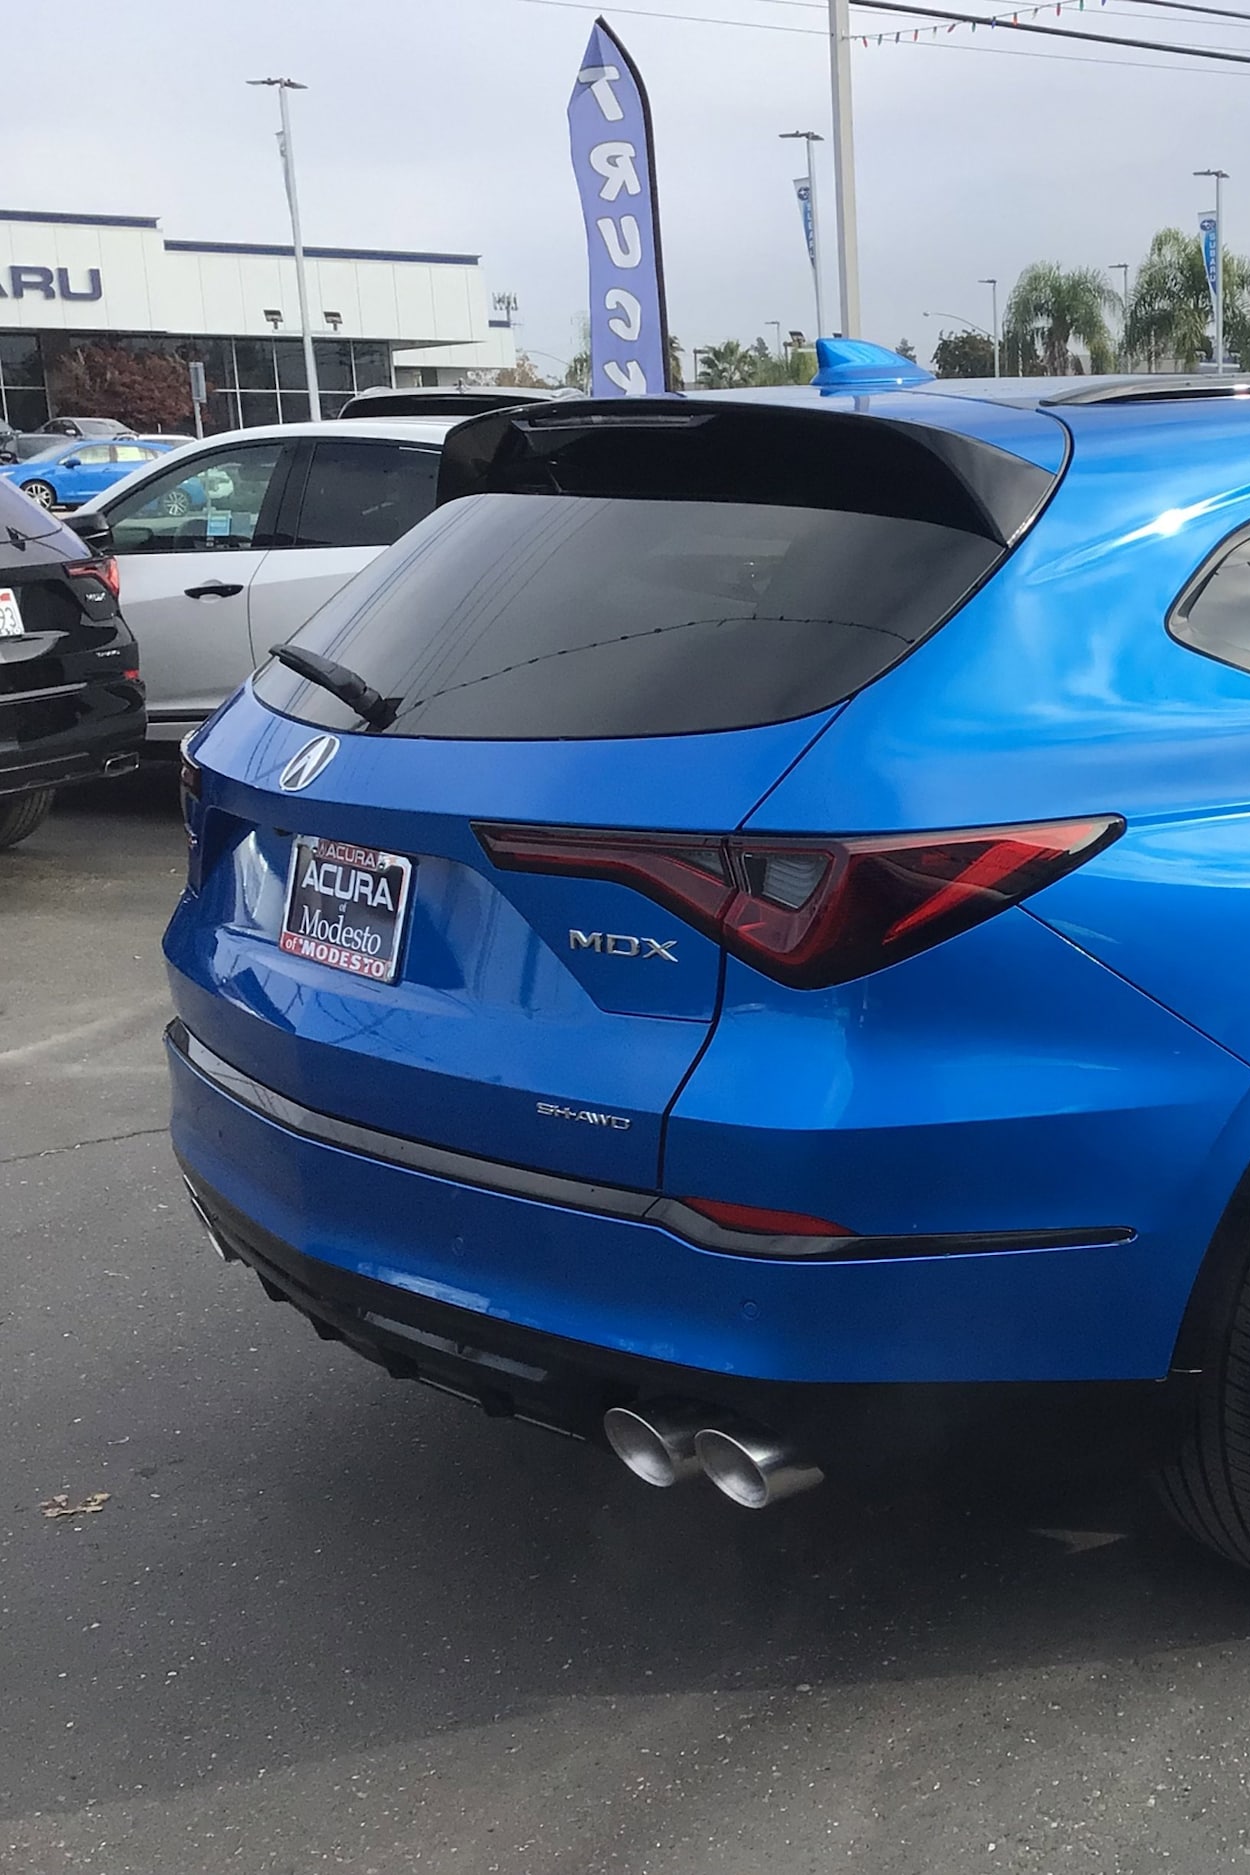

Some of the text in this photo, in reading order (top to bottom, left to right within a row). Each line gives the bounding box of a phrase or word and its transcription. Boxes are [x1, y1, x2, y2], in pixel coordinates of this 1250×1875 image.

[0, 265, 103, 302] RU
[326, 843, 377, 868] ACURA
[301, 859, 394, 912] ACURA
[298, 905, 382, 955] Modesto
[568, 929, 679, 963] MDX
[284, 937, 386, 978] of MODESTO
[535, 1101, 633, 1131] SH-AWD
